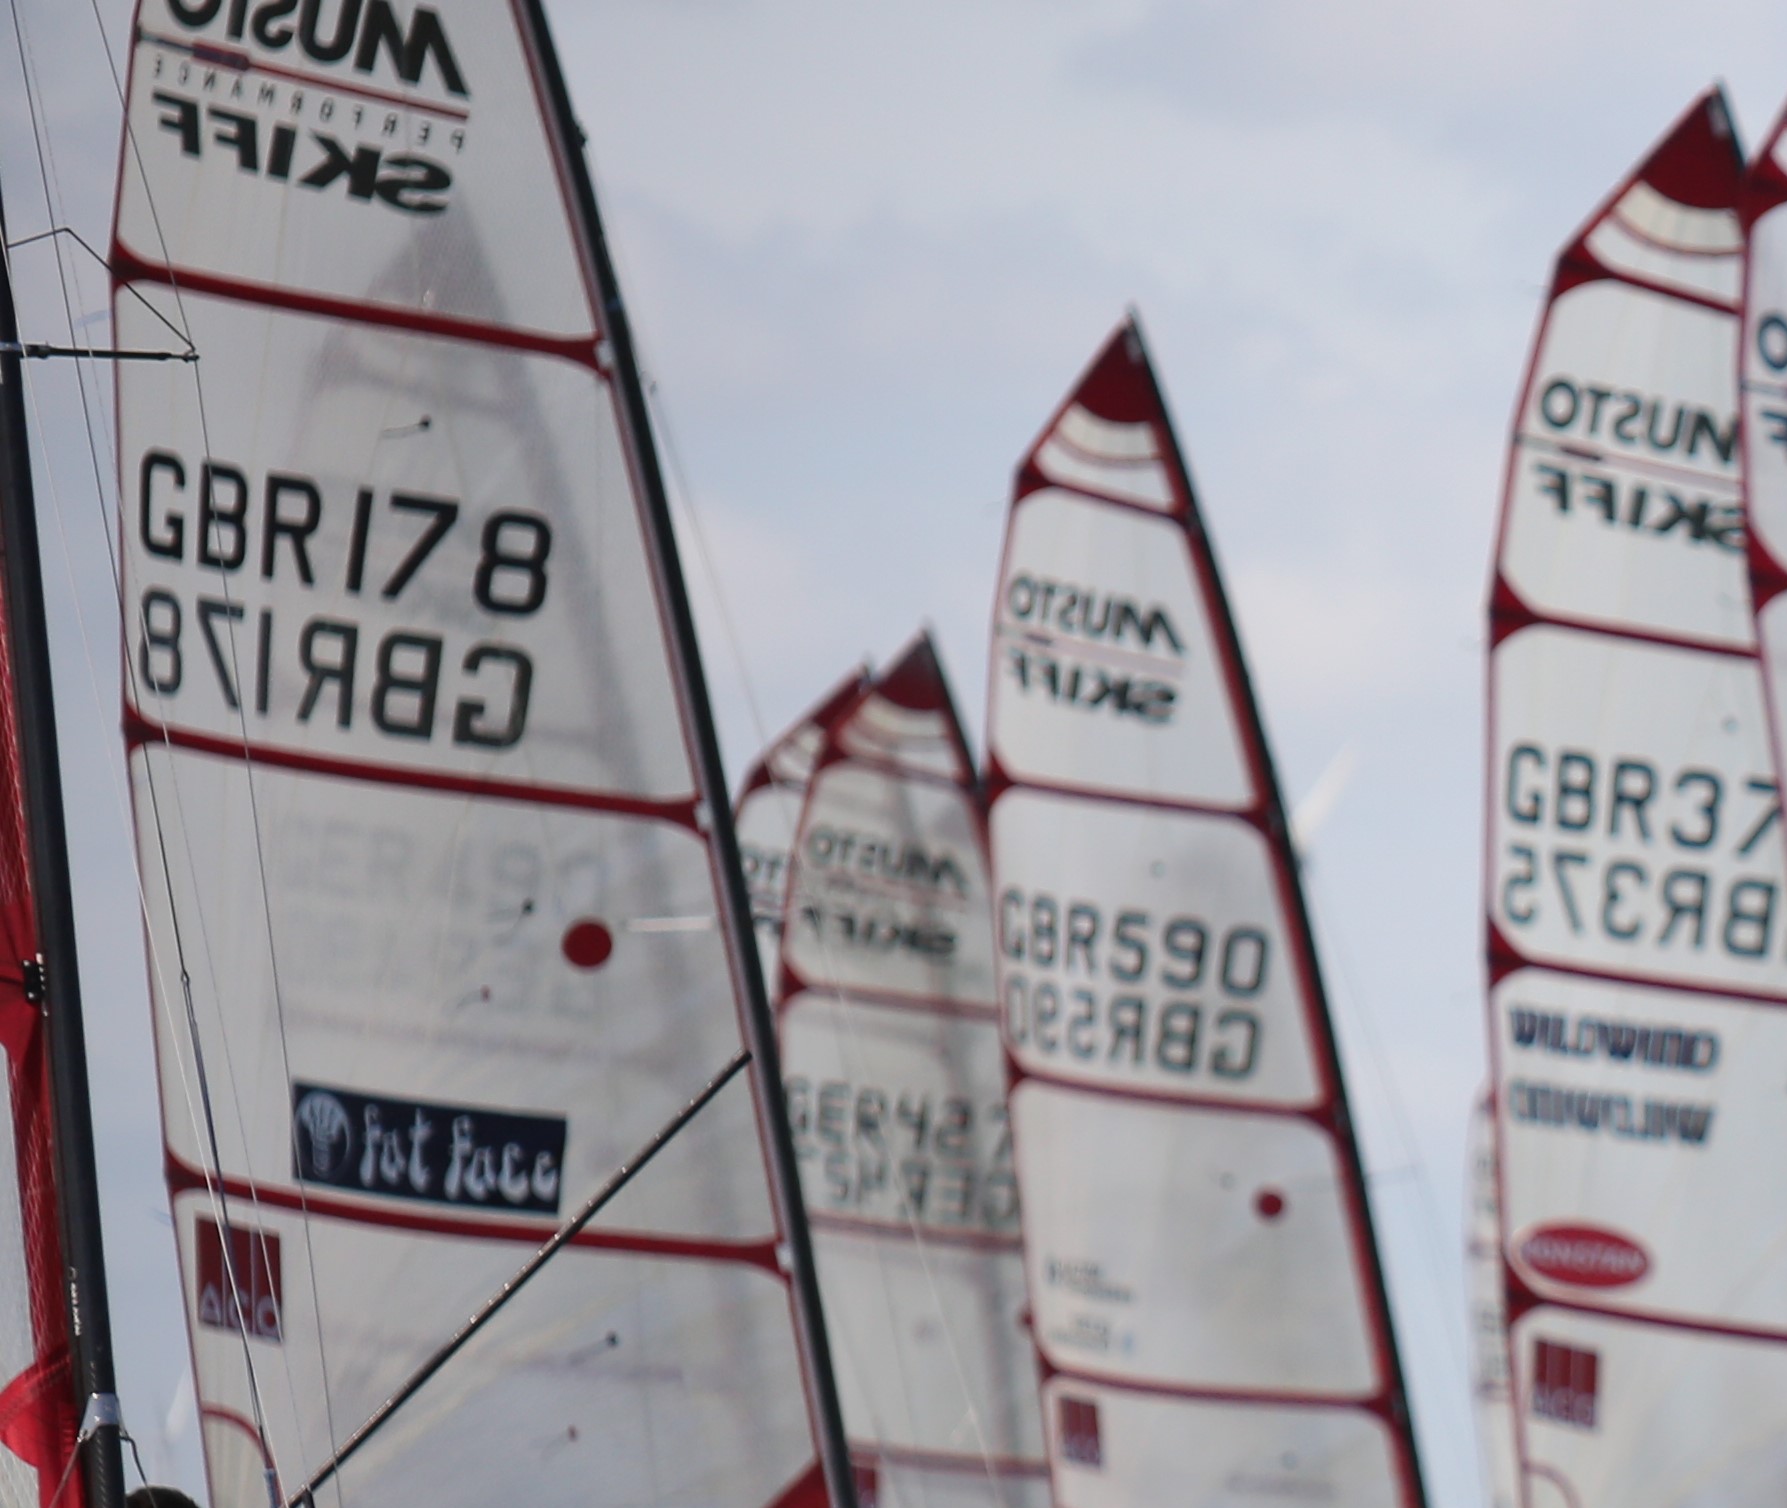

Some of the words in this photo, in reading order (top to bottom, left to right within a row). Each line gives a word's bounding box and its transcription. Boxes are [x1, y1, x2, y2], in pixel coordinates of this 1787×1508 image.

[138, 448, 553, 618] GBR178
[1000, 884, 1269, 999] GBR590
[200, 1282, 284, 1340] ACO
